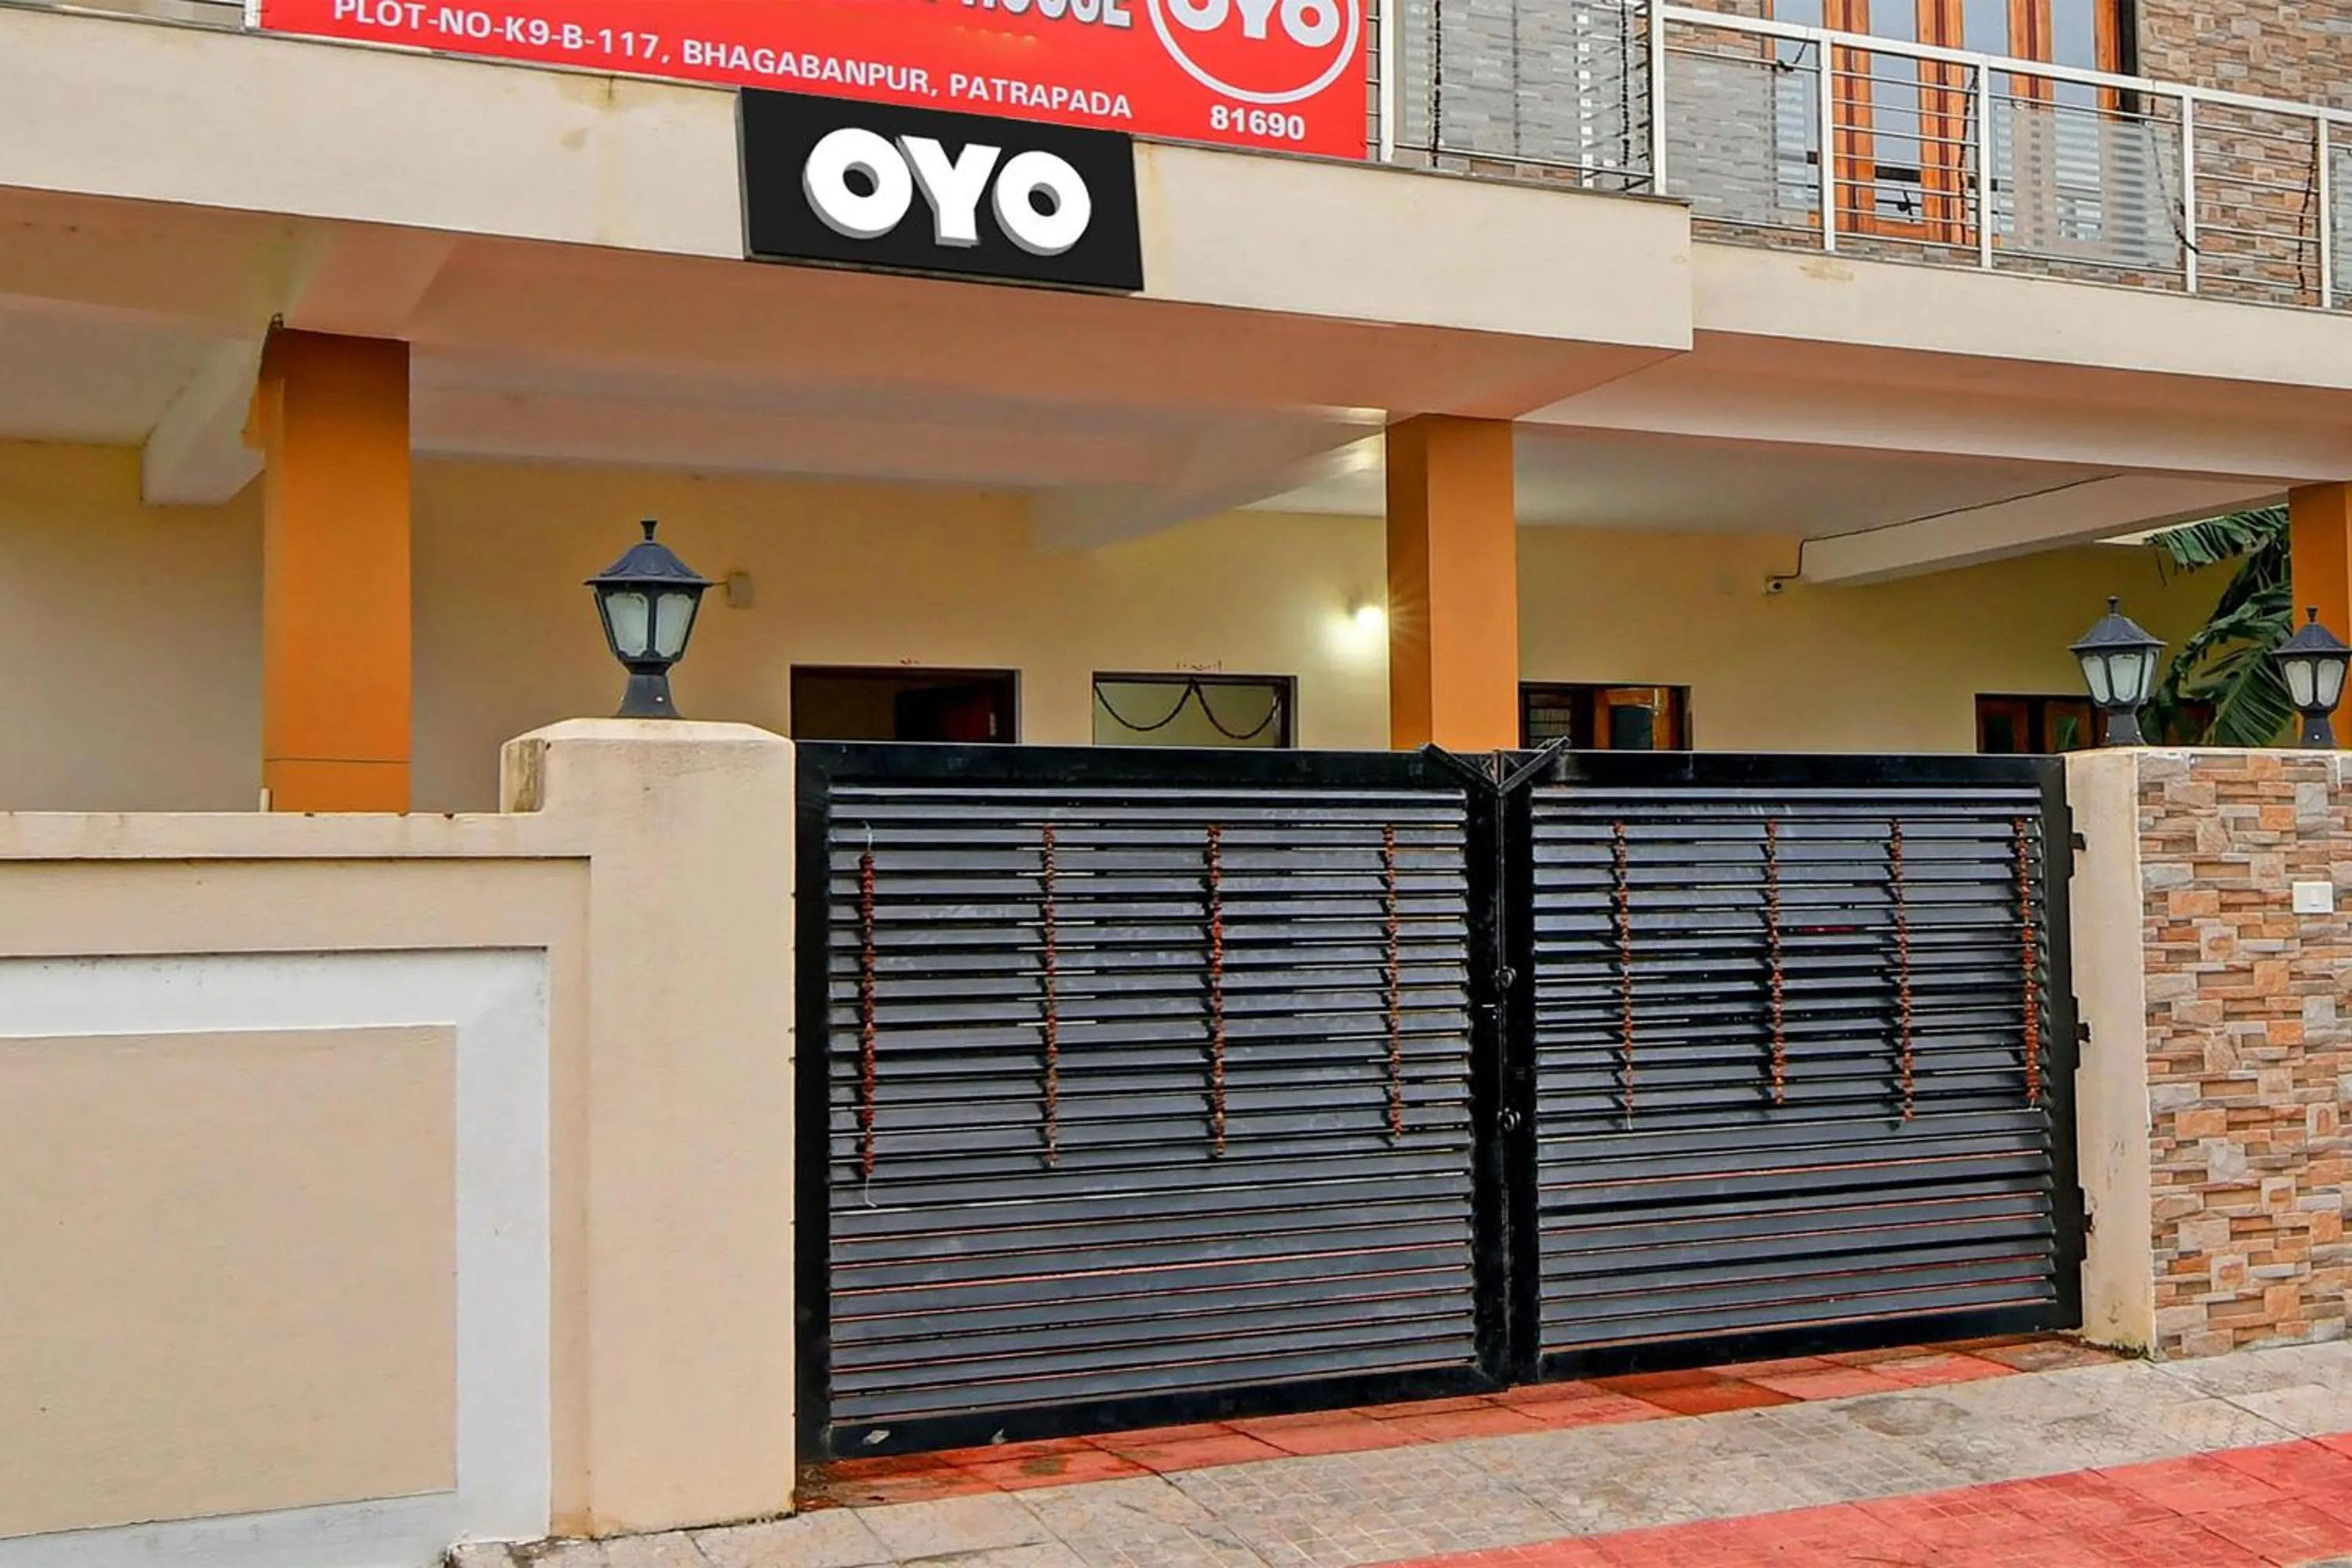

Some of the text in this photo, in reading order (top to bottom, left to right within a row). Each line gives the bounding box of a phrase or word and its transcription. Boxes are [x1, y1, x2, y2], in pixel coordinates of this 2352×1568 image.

[334, 0, 1133, 119] PLOT-NO-K9-B-117, BHAGABANPUR, PATRAPADA
[1210, 105, 1305, 140] 81690
[803, 127, 1092, 256] OYO
